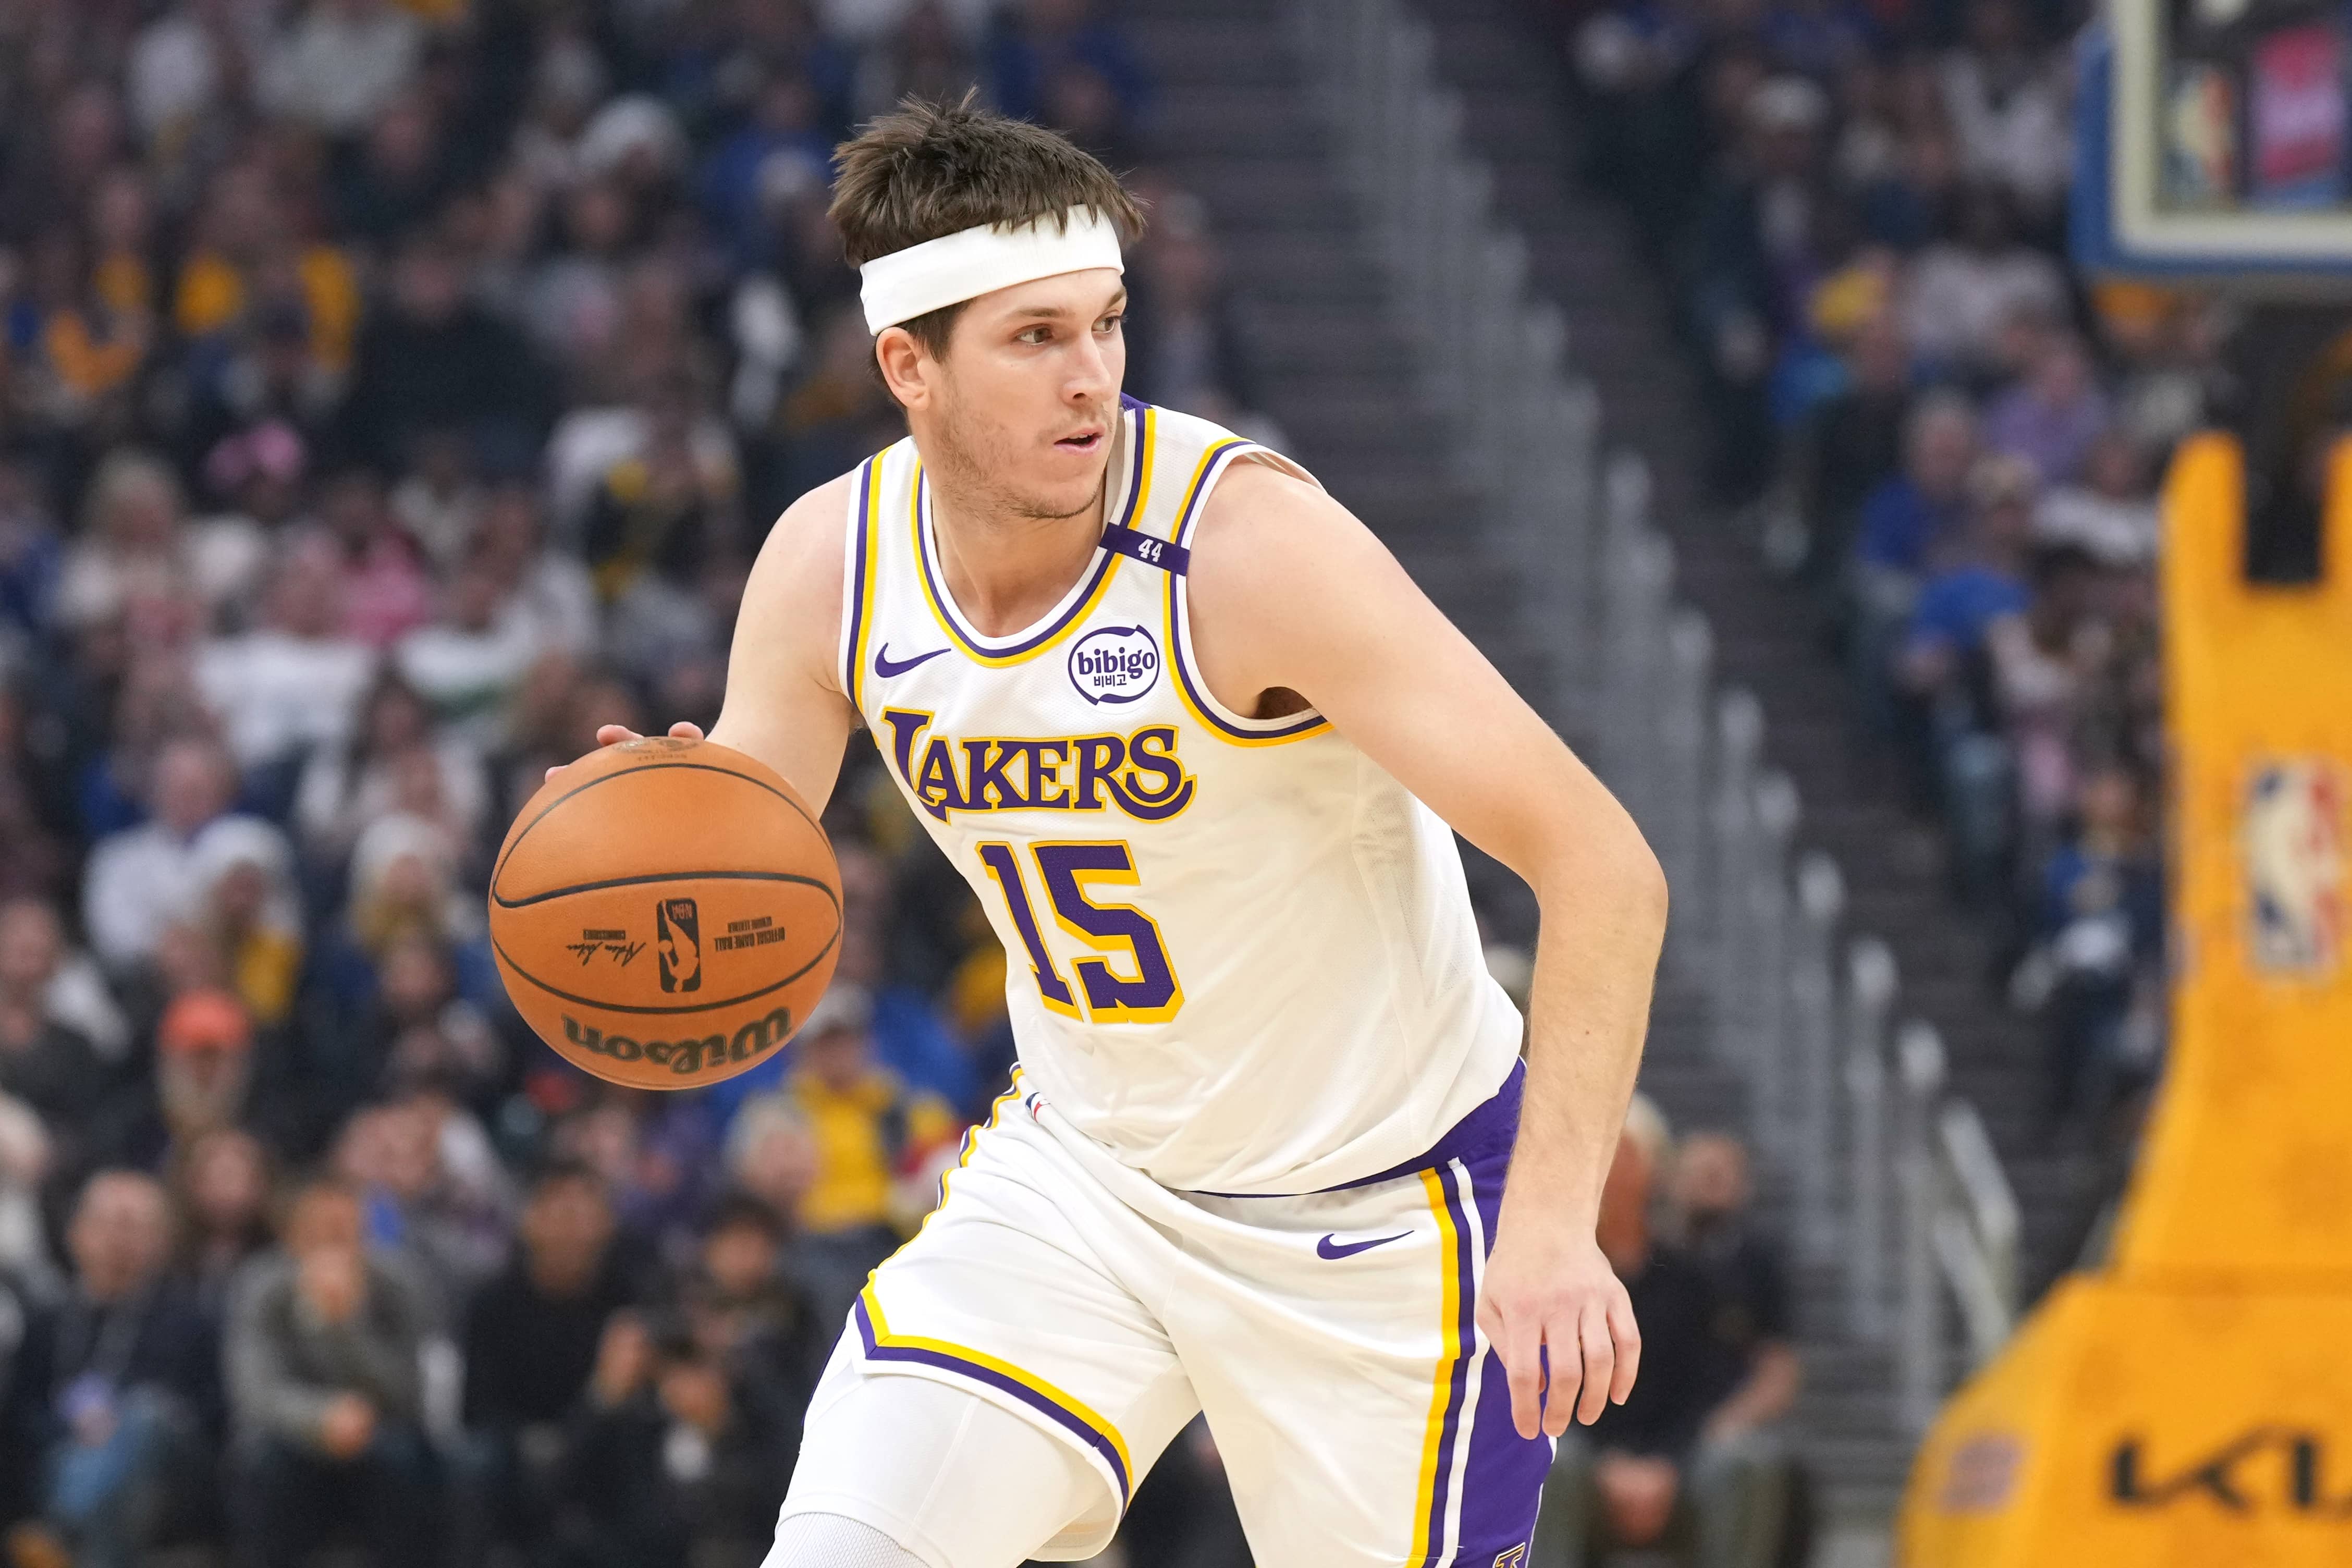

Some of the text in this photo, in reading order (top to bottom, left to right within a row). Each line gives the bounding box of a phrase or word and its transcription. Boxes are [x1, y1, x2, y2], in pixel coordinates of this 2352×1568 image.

[1138, 538, 1163, 562] 44
[1077, 647, 1155, 679] bibigo
[1094, 674, 1127, 688] 비비고
[881, 707, 1197, 825] LAKERS
[671, 903, 693, 919] NBA
[974, 840, 1184, 1024] 15
[561, 1007, 791, 1074] Wilson
[2111, 1426, 2352, 1512] KI
